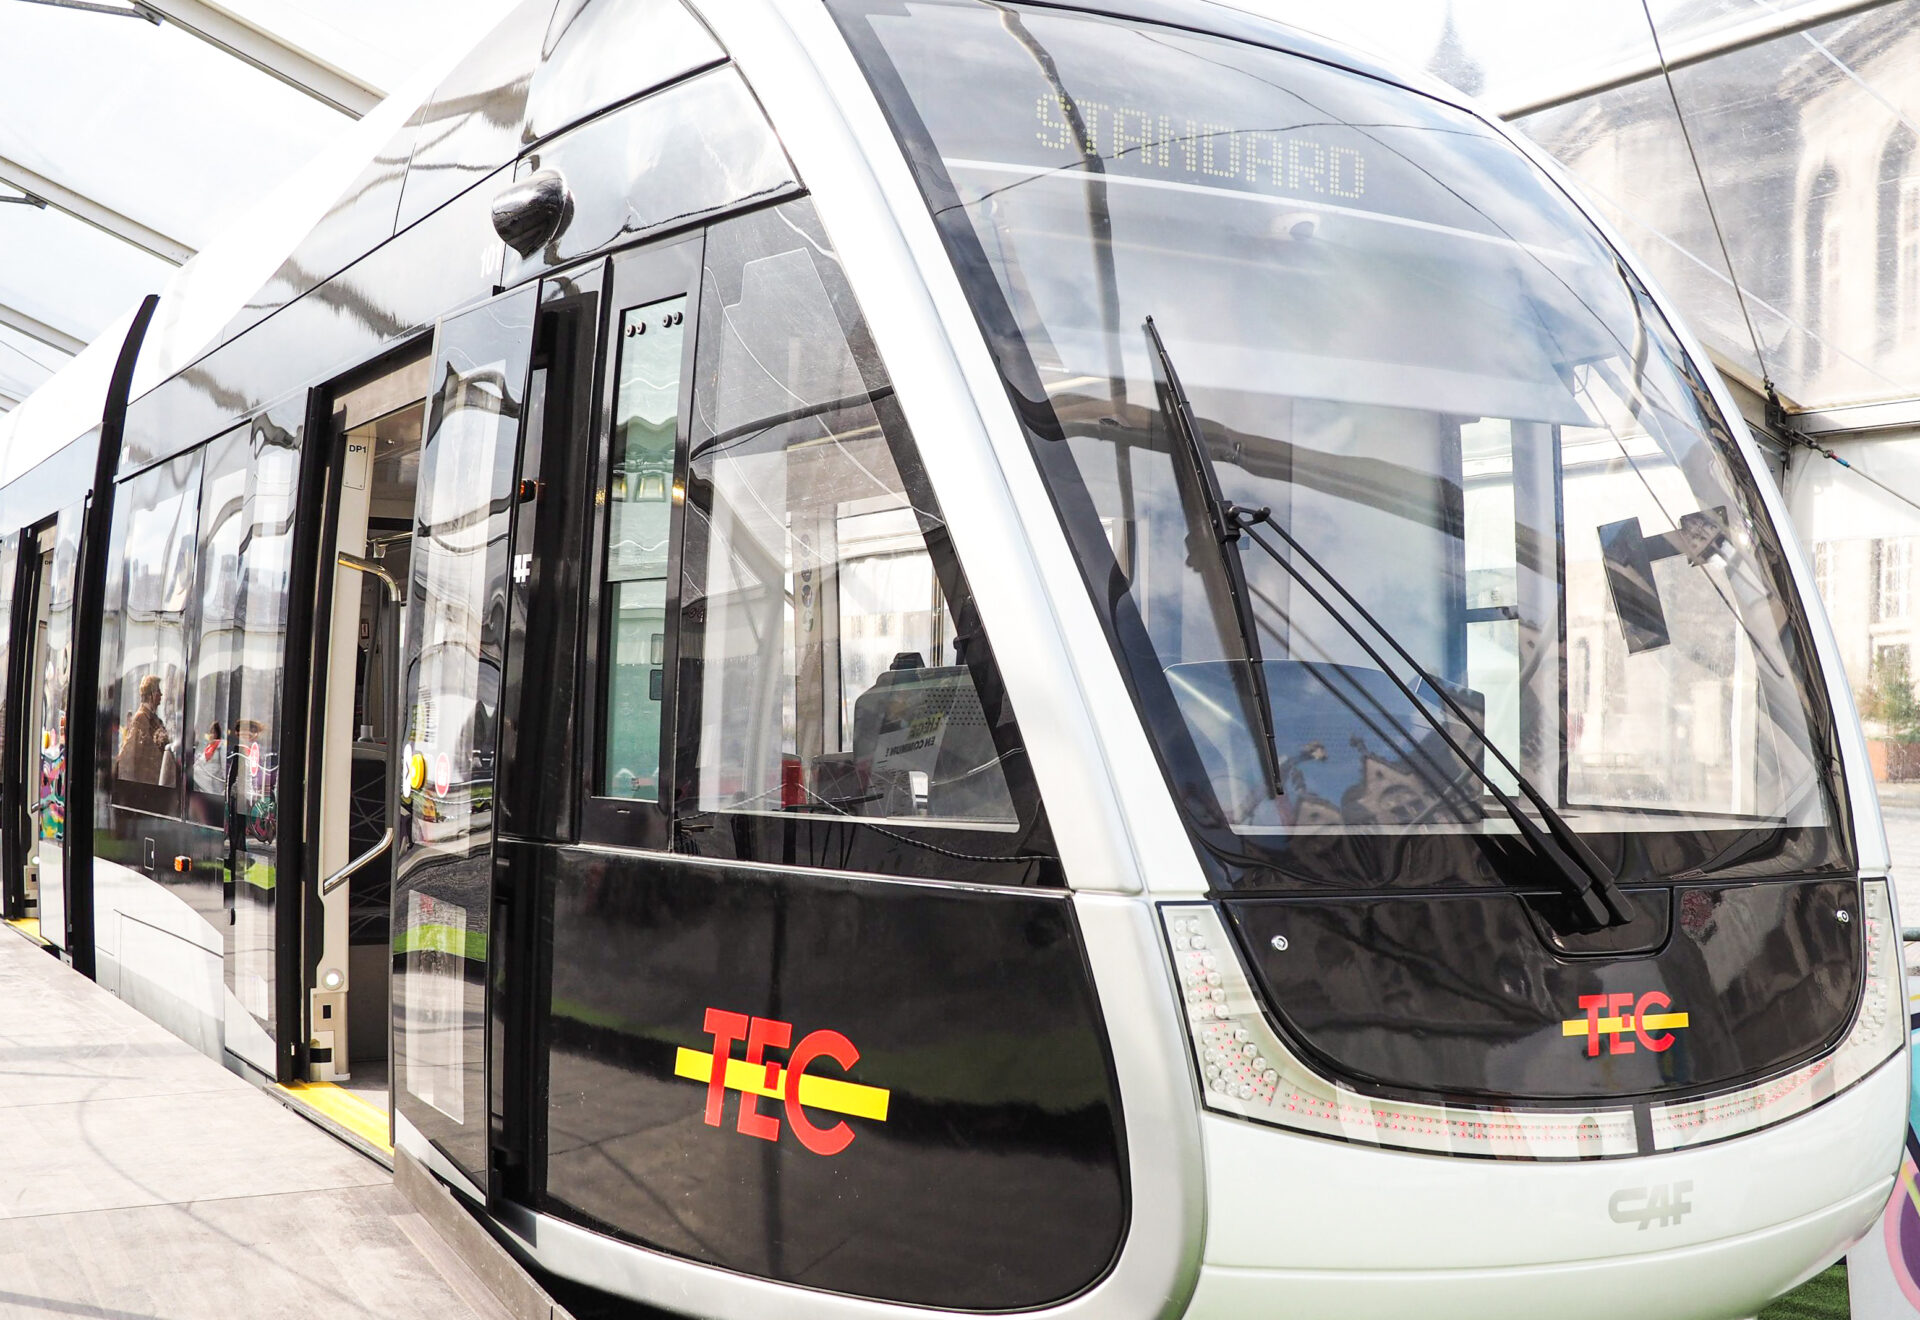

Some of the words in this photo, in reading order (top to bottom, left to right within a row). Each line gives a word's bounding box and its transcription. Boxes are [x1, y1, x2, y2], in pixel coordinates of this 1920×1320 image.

[1036, 93, 1365, 199] STANDARD
[348, 444, 367, 454] DP1
[1578, 991, 1676, 1057] TEC
[703, 1007, 860, 1156] TEC
[1608, 1179, 1694, 1231] CAF
